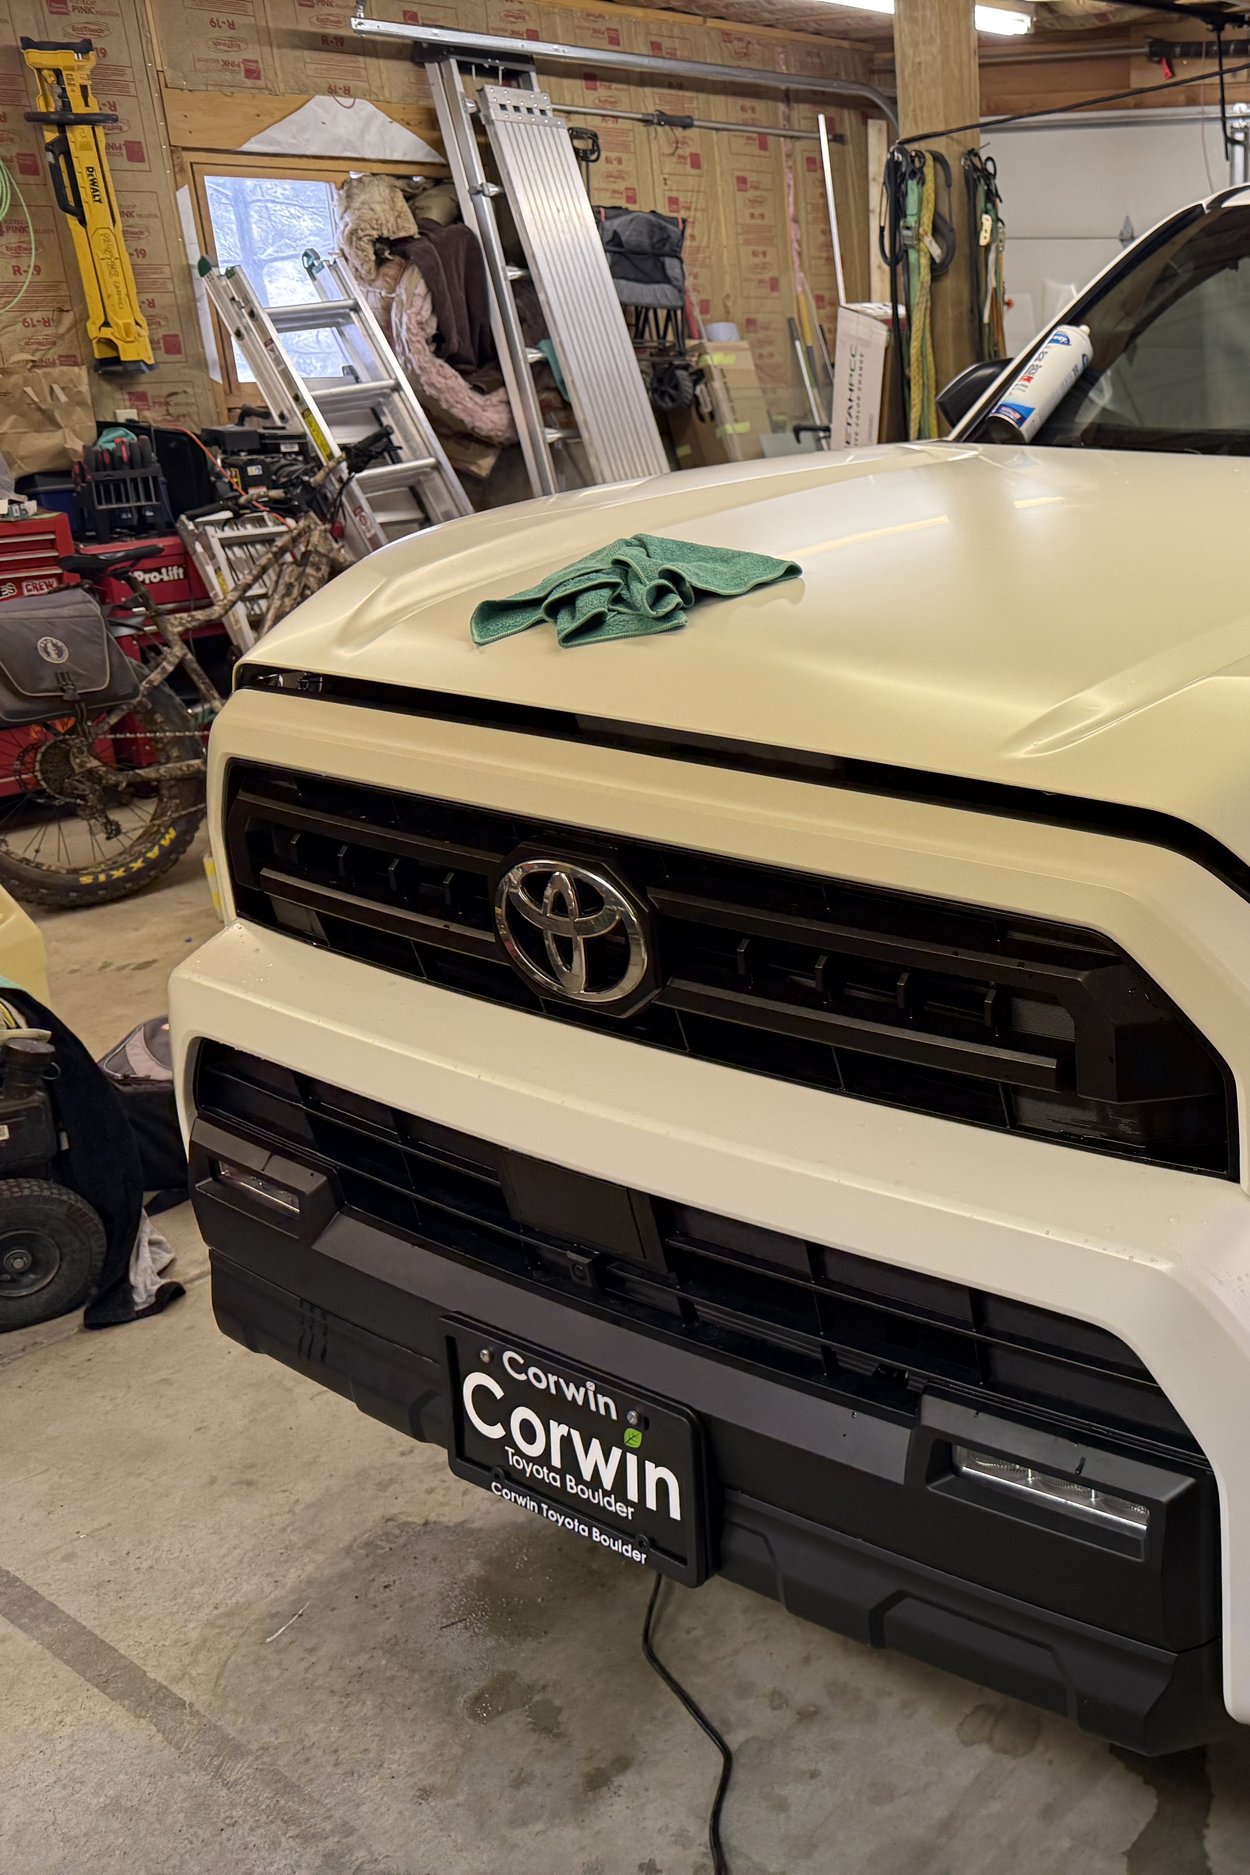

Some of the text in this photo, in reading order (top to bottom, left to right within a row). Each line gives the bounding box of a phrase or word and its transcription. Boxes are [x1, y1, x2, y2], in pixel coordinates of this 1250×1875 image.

[71, 5, 95, 15] PINK
[209, 17, 236, 30] R-19
[327, 84, 351, 95] R-19
[120, 209, 136, 219] INK
[5, 225, 29, 234] PINK
[22, 317, 53, 328] R-19
[25, 580, 56, 593] CREW
[79, 826, 177, 885] MAXXIS
[502, 1350, 618, 1421] Corwin
[462, 1371, 681, 1521] Corwin
[504, 1446, 635, 1520] Toyota Boulder
[490, 1482, 647, 1565] Corwin Toyota Boulder
